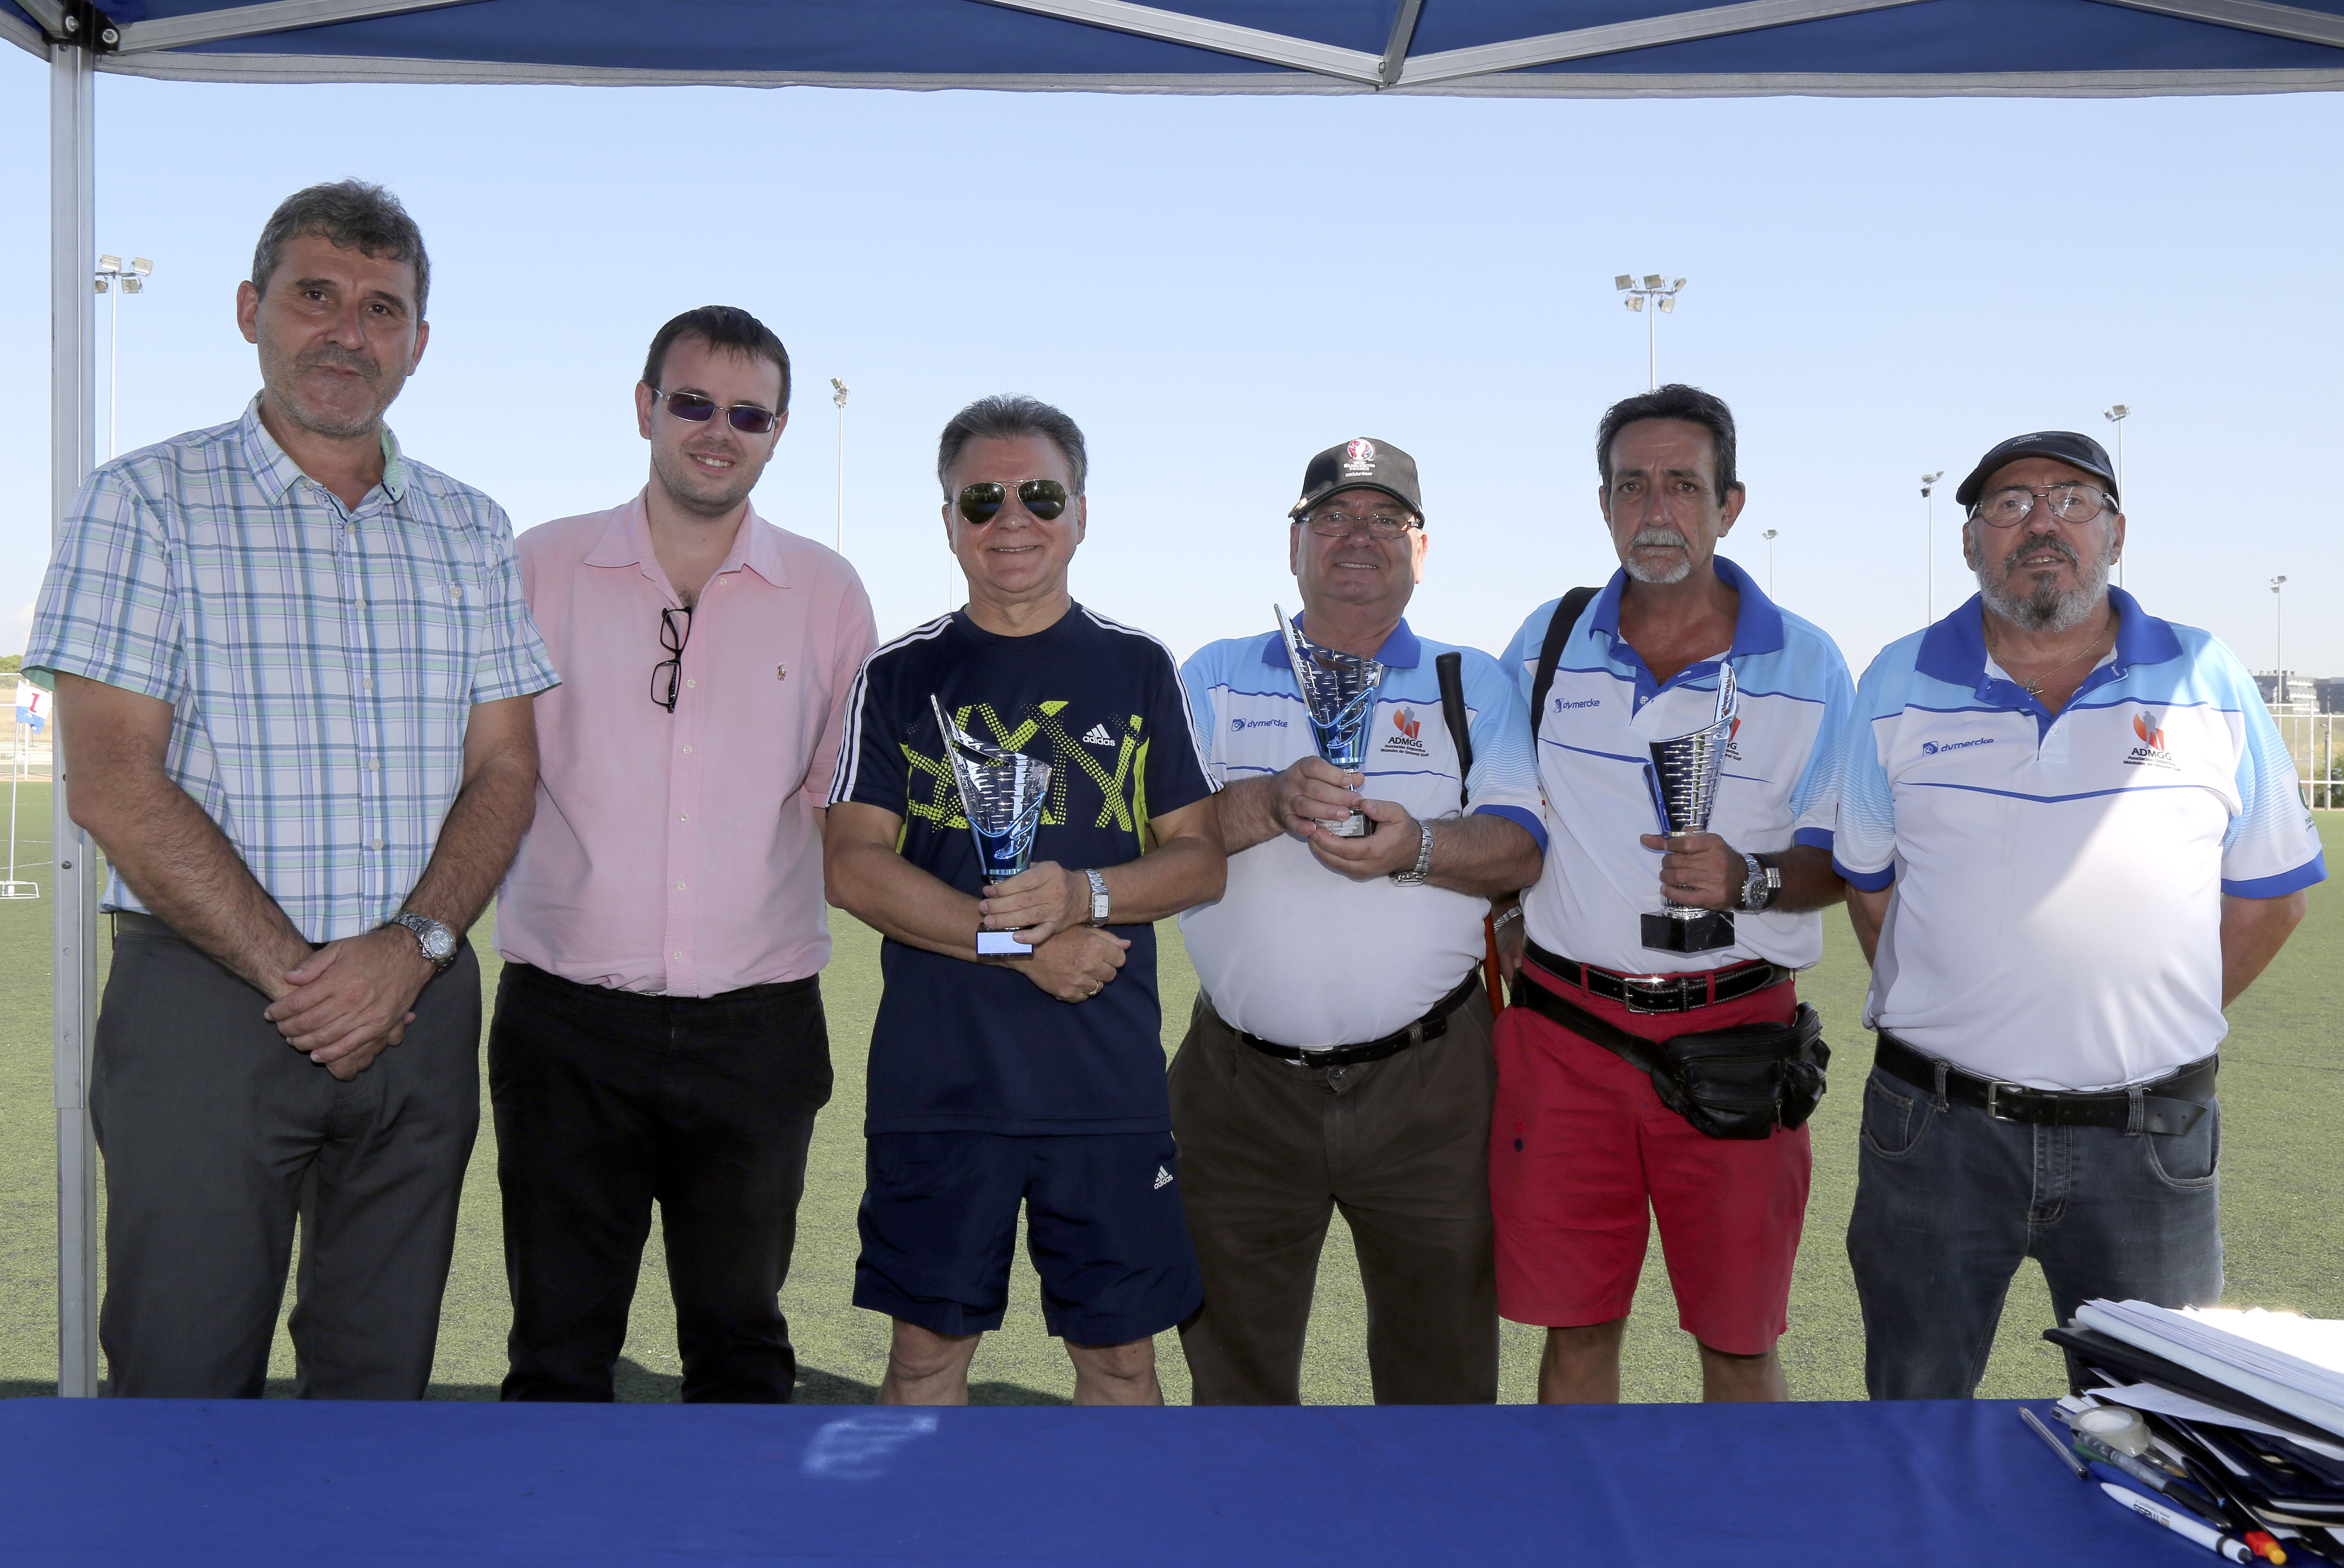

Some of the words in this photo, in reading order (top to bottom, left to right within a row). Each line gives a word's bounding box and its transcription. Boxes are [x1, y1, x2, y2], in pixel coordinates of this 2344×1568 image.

[29, 693, 40, 713] 1
[1563, 698, 1600, 709] dymercke
[1247, 719, 1287, 728] dymercke
[1082, 736, 1116, 746] adidas
[1388, 737, 1422, 748] ADMGG
[1941, 738, 1994, 752] dymercke
[2131, 748, 2172, 761] ADMGG
[1154, 1174, 1173, 1189] adidas
